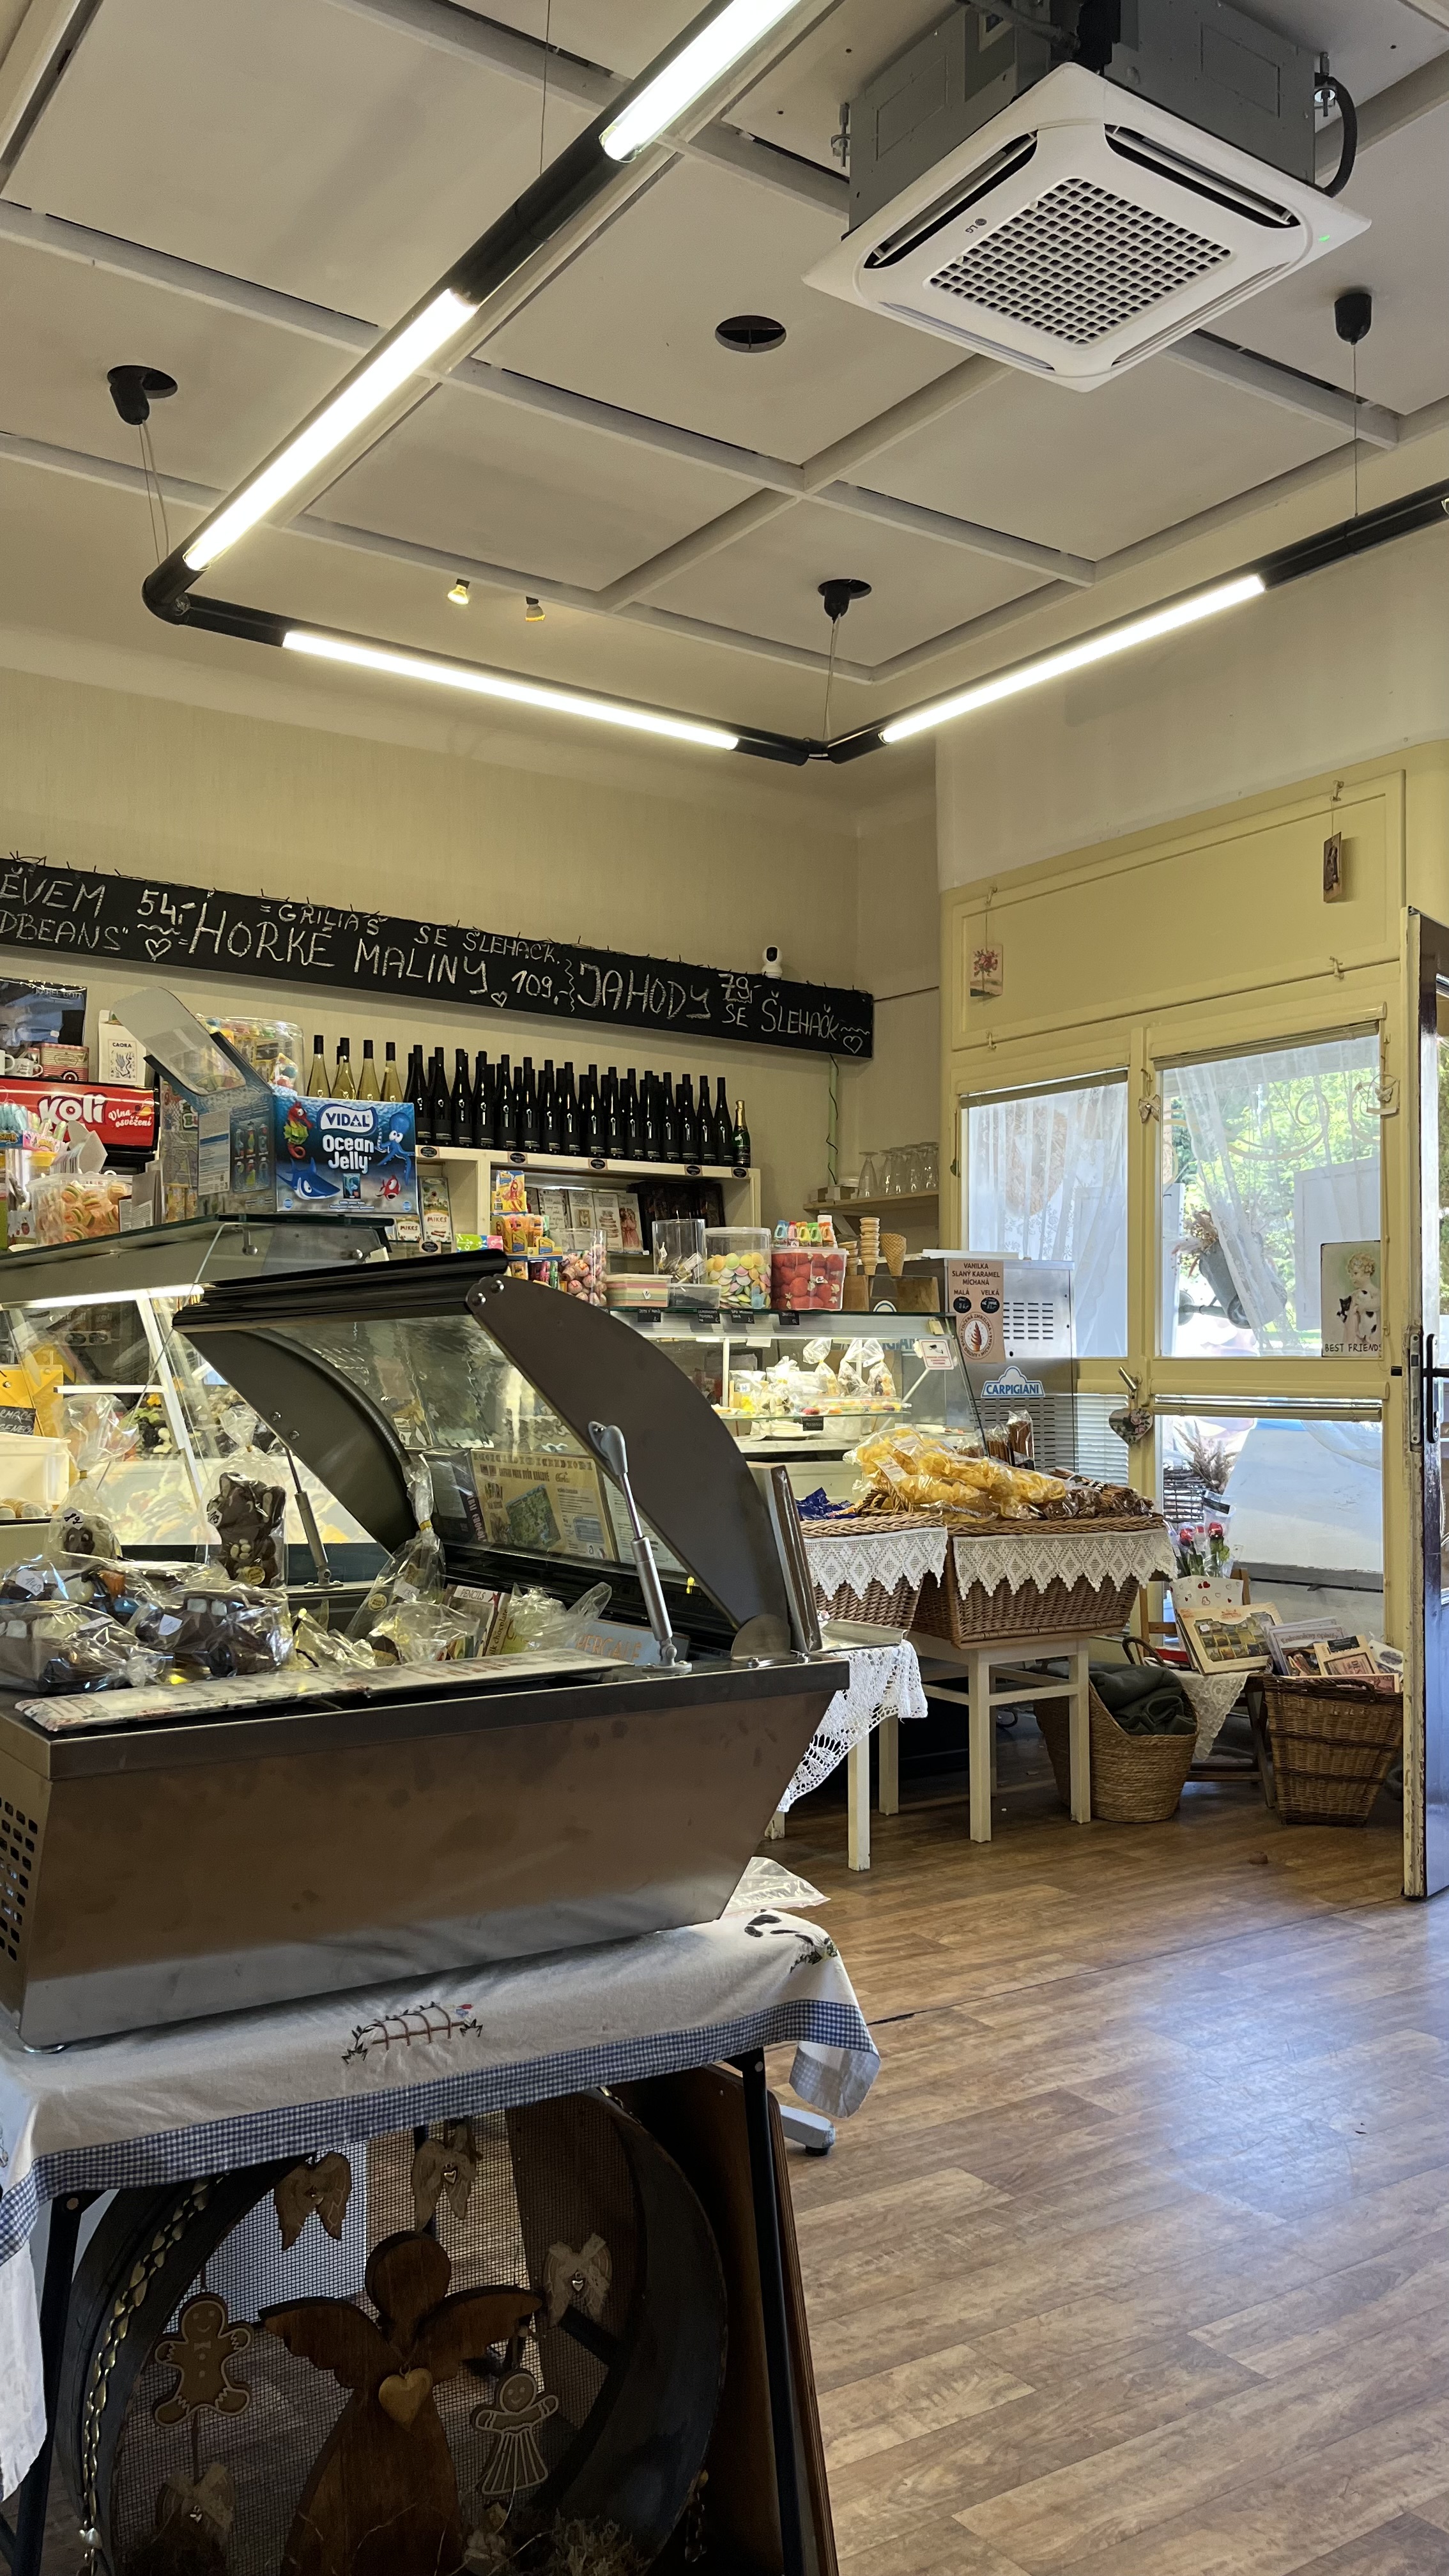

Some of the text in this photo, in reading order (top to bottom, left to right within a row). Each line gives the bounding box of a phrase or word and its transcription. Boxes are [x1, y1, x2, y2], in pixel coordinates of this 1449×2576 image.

[965, 225, 978, 233] LG
[414, 925, 448, 947] SE
[188, 901, 335, 968] HORKÉ
[354, 938, 488, 995] MALINY
[577, 961, 711, 1020] JAHODY
[721, 1004, 749, 1028] SE
[108, 1108, 132, 1121] Vlna
[326, 1113, 371, 1128] VIDAL
[322, 1134, 374, 1153] Ocean
[328, 1151, 369, 1174] Jelly
[1324, 1344, 1344, 1353] BEST
[986, 1384, 1039, 1395] CARPIGIANI
[460, 1588, 486, 1600] PENCILS
[494, 1609, 509, 1645] chocolate
